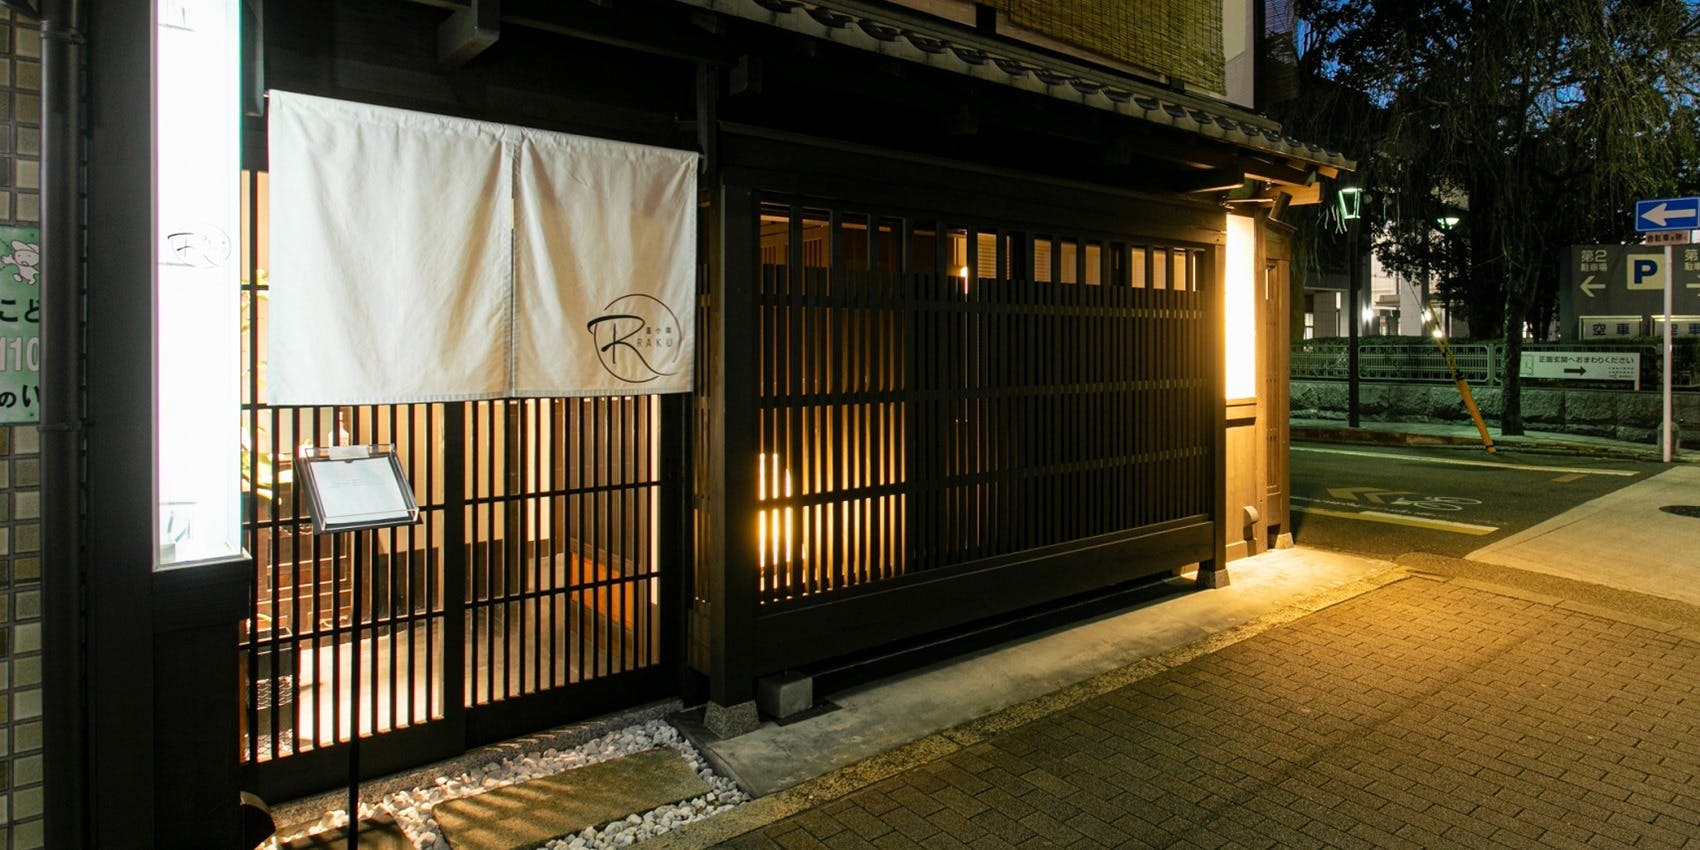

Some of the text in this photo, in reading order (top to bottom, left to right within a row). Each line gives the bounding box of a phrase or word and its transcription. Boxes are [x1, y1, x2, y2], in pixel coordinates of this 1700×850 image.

[1581, 249, 1607, 262] 第2
[1634, 260, 1657, 284] P
[0, 298, 39, 323] こど
[637, 338, 672, 347] RAKU
[1538, 355, 1634, 364] 正面玄関へおまわりください
